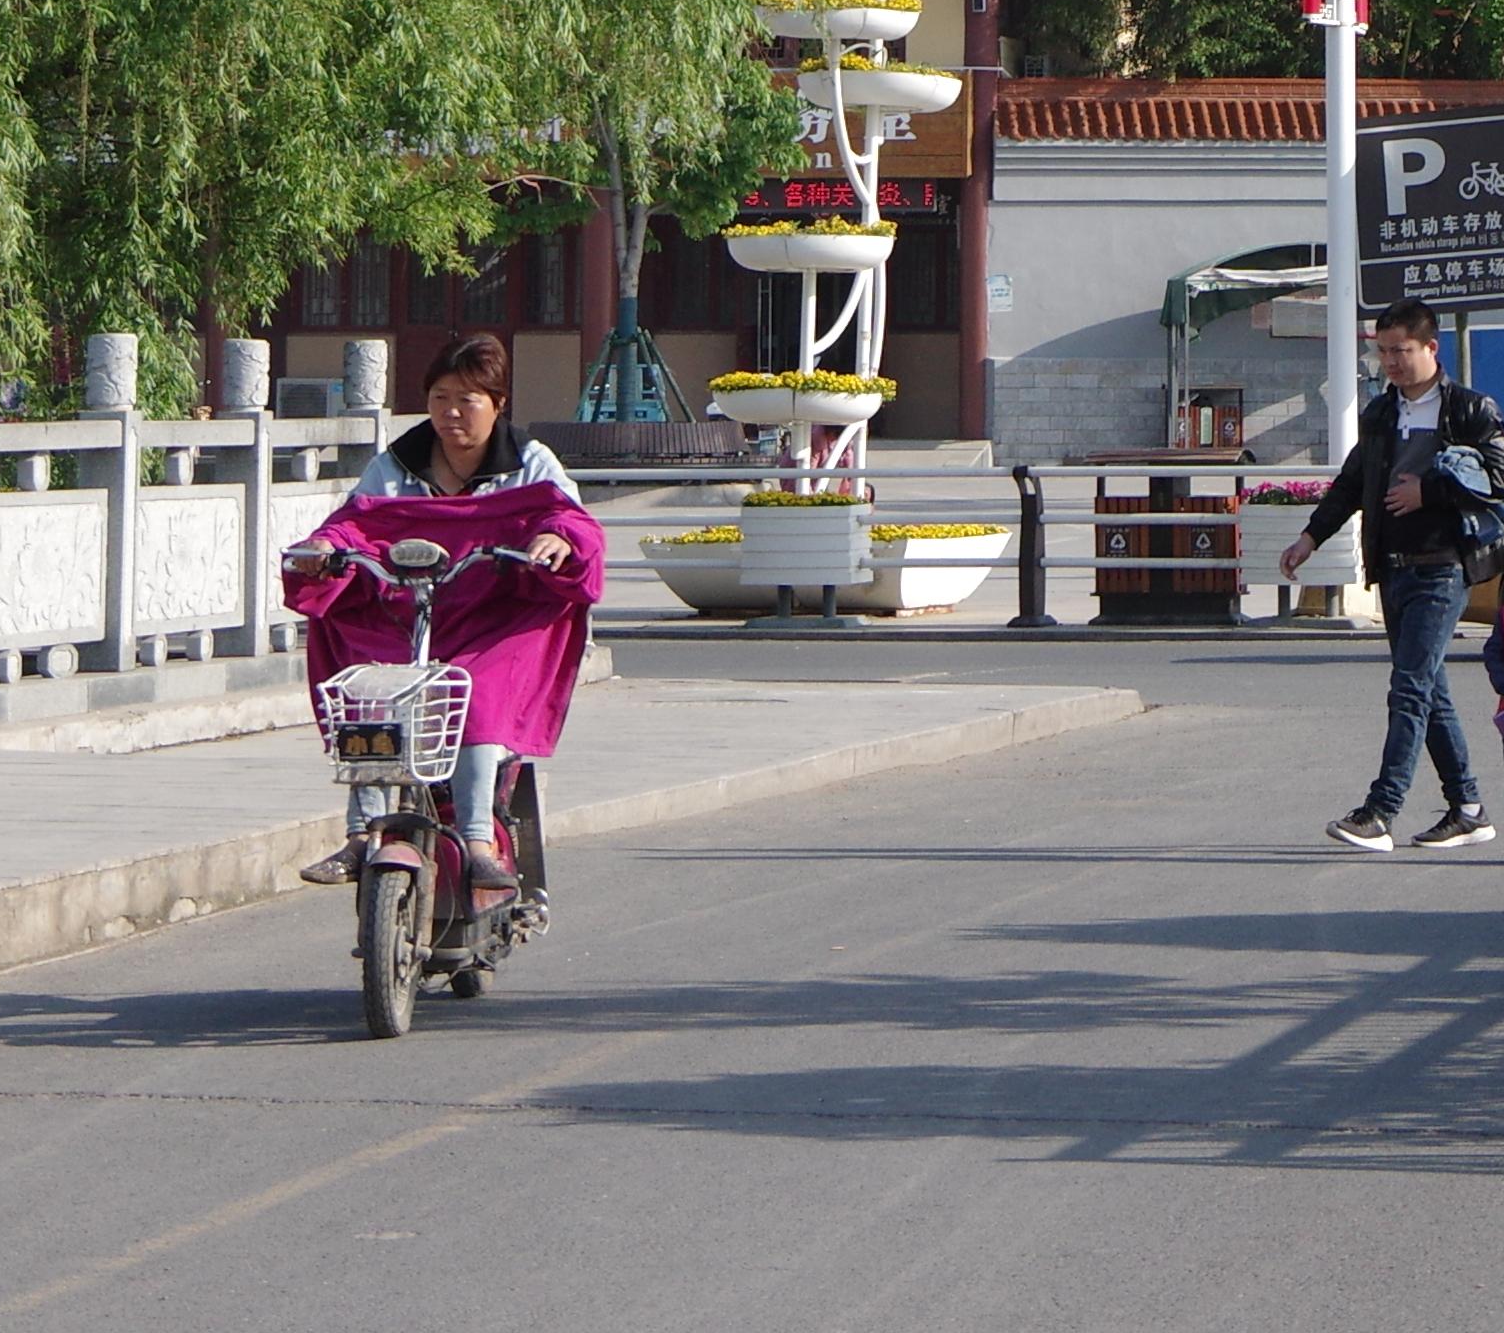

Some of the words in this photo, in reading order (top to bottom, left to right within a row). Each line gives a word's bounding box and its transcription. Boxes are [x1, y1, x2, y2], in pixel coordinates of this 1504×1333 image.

[1382, 138, 1445, 216] P
[1415, 239, 1435, 250] vehicle
[1437, 237, 1459, 249] storage
[1404, 286, 1440, 298] Emergency
[1441, 284, 1468, 295] Parking
